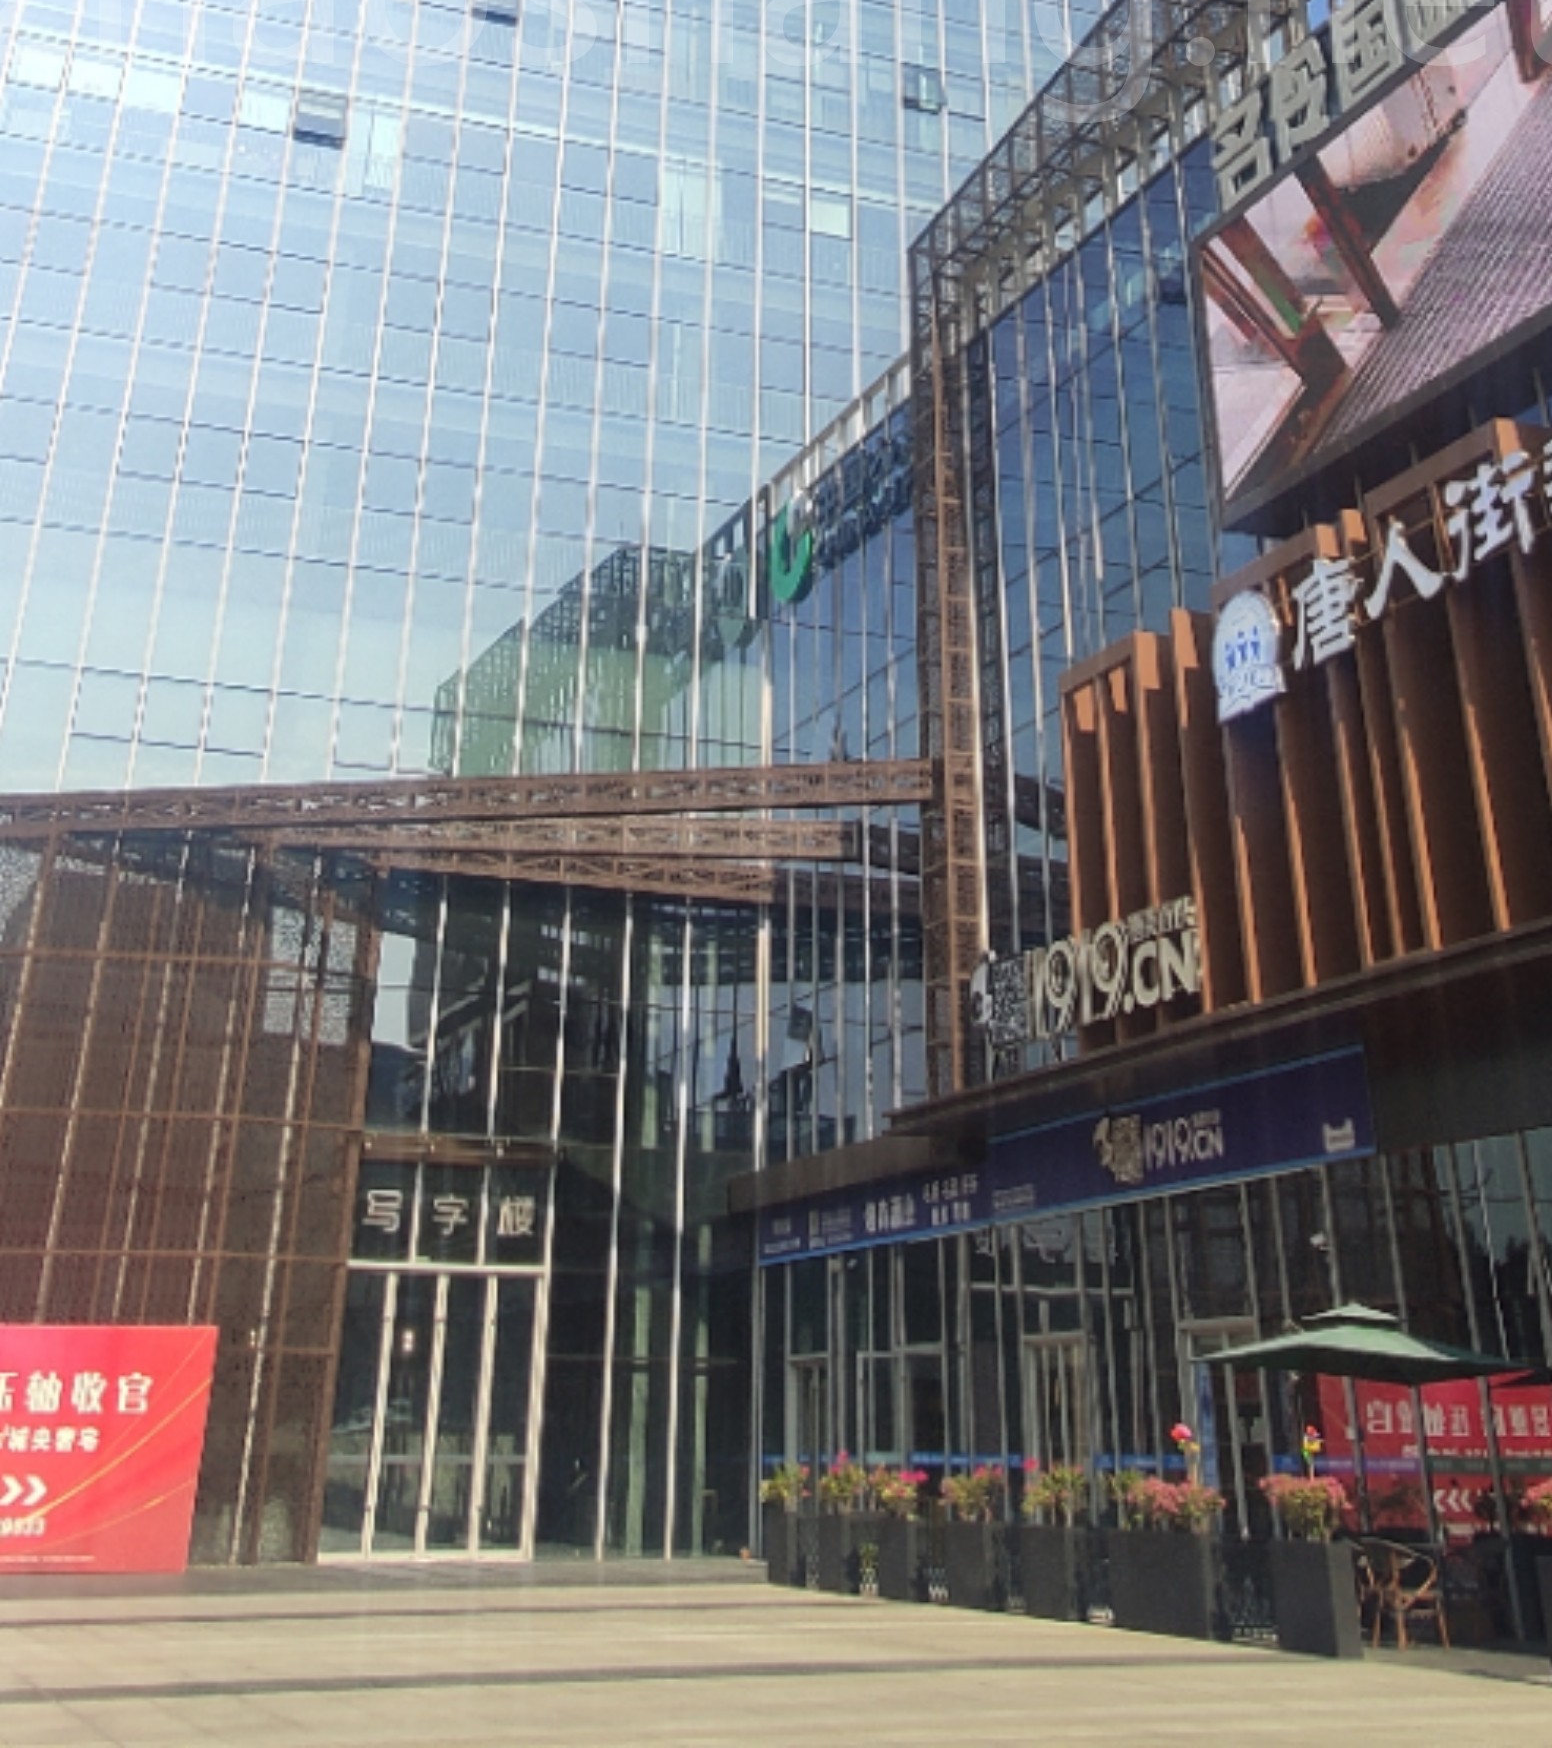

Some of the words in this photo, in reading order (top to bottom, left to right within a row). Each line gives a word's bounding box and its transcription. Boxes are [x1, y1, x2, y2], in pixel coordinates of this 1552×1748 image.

[1025, 919, 1203, 1042] 1919.CN
[361, 1187, 536, 1237] 写字楼
